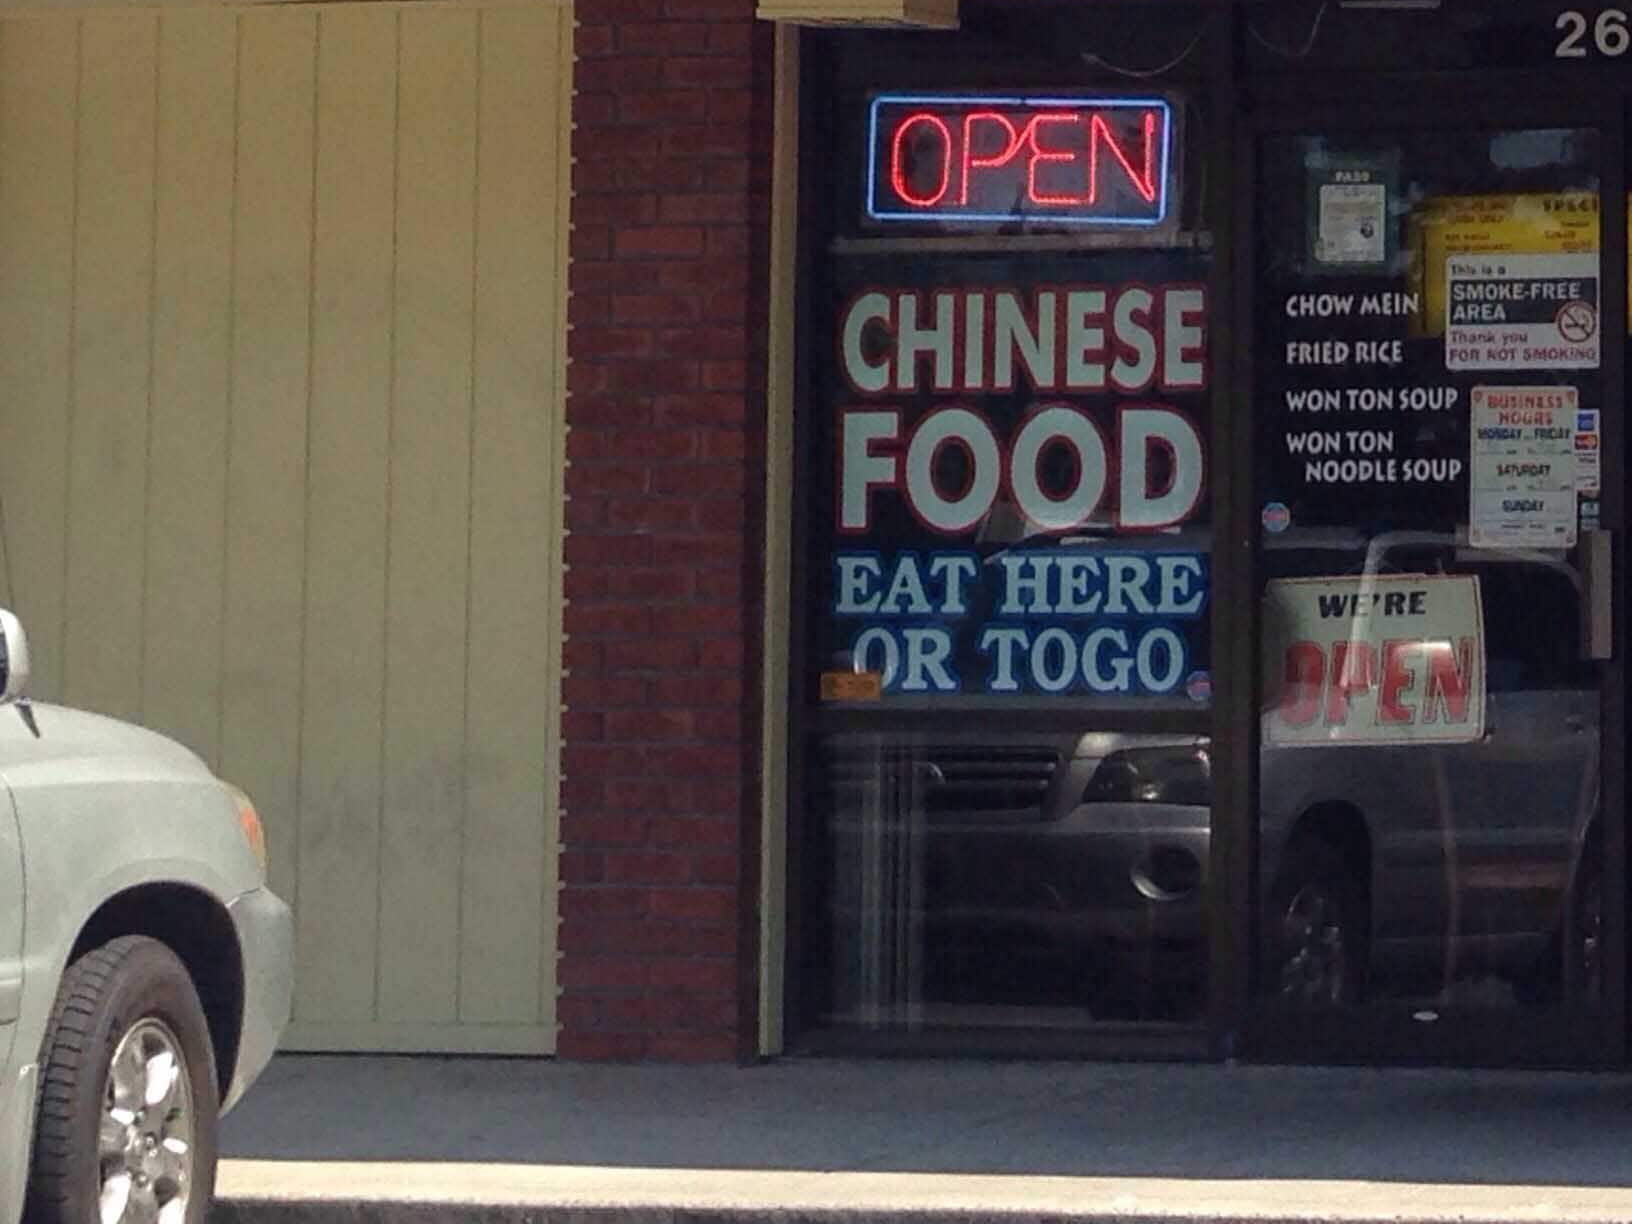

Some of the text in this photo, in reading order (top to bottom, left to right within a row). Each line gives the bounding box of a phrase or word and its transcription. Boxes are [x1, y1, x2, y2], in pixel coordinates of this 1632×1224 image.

[891, 113, 1156, 206] OPEN
[1453, 282, 1581, 301] SMOKE-FREE
[1286, 293, 1420, 317] CHOW MEIN
[1453, 304, 1507, 321] AREA
[842, 289, 1203, 391] CHINESE
[1450, 330, 1529, 345] Thank you
[1286, 340, 1404, 364] FRIED RICE
[1450, 347, 1596, 362] FOR NOT SMOKING
[1286, 388, 1458, 411] WON TON SOUP
[1487, 395, 1563, 409] BUSINESS
[1498, 412, 1553, 426] HOURS
[1286, 431, 1393, 454] WON TON
[842, 408, 1203, 530] FOOD
[1305, 458, 1462, 482] NOODLE SOUP
[835, 555, 1203, 614] EAT HERE
[1318, 591, 1427, 619] WE'RE
[853, 627, 957, 691] OR
[1279, 635, 1475, 726] OPEN
